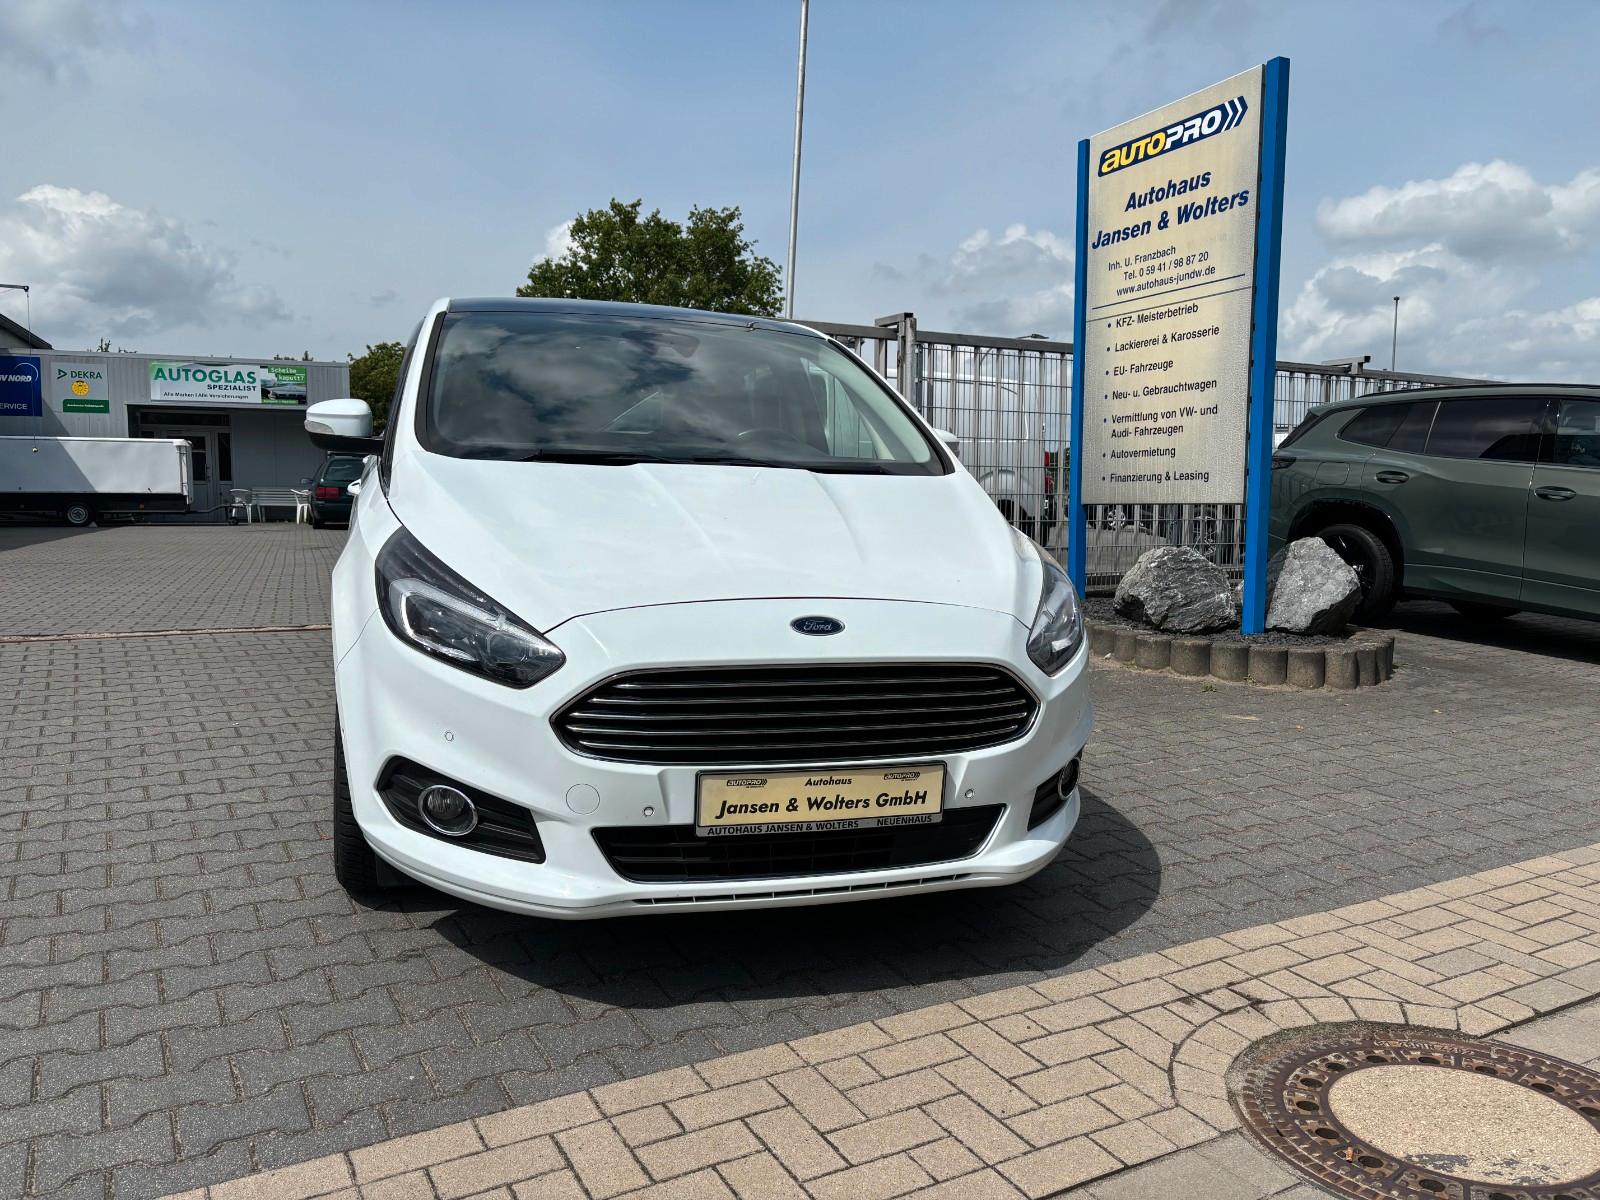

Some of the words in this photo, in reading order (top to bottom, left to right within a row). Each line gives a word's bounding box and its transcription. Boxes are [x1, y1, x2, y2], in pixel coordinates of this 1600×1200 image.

[1125, 171, 1211, 212] Autohaus
[1092, 221, 1151, 250] Jansen
[1158, 211, 1169, 231] &
[1177, 189, 1249, 224] Wolters
[1108, 259, 1122, 271] Inh.
[1124, 257, 1132, 267] U.
[1135, 246, 1176, 264] Franzbach
[1124, 269, 1137, 280] Tel.
[1139, 268, 1144, 277] 0
[1146, 265, 1156, 275] 59
[1157, 262, 1166, 273] 41
[1174, 258, 1184, 268] 98
[1186, 255, 1196, 266] 87
[1198, 251, 1209, 262] 20
[1116, 265, 1216, 296] www.autohaus-jundw.de
[1116, 315, 1135, 328] KFZ-
[1137, 303, 1198, 324] Meisterbetrieb
[1115, 336, 1159, 352] Lackiererei
[1163, 335, 1168, 344] &
[1171, 326, 1220, 342] Karosserie
[71, 371, 102, 379] DEKRA
[154, 368, 256, 384] AUTOGLAS
[1114, 366, 1127, 376] EU-
[1130, 359, 1174, 373] Fahrzeuge
[1112, 390, 1130, 400] Neu-
[1143, 379, 1217, 397] Gebrauchtwagen
[1112, 410, 1158, 424] Vermittlung
[1161, 411, 1176, 419] von
[1179, 407, 1198, 417] VW-
[1200, 405, 1218, 415] und
[1111, 428, 1132, 438] Audi-
[1134, 424, 1184, 436] Fahrzeugen
[1110, 447, 1176, 459] Autovermietung
[1110, 473, 1162, 483] Finanzierung
[1174, 471, 1209, 482] Leasing
[804, 621, 832, 630] Ford
[804, 776, 852, 787] Autohaus
[715, 800, 780, 819] Jansen
[786, 797, 799, 812] &
[807, 792, 870, 811] Wolters
[876, 790, 928, 808] GmbH
[708, 825, 763, 836] AUTOHAUS
[764, 822, 804, 832] JANSEN
[806, 822, 813, 831] &
[816, 820, 859, 830] WOLTERS
[877, 815, 932, 827] NEUENHAUS
